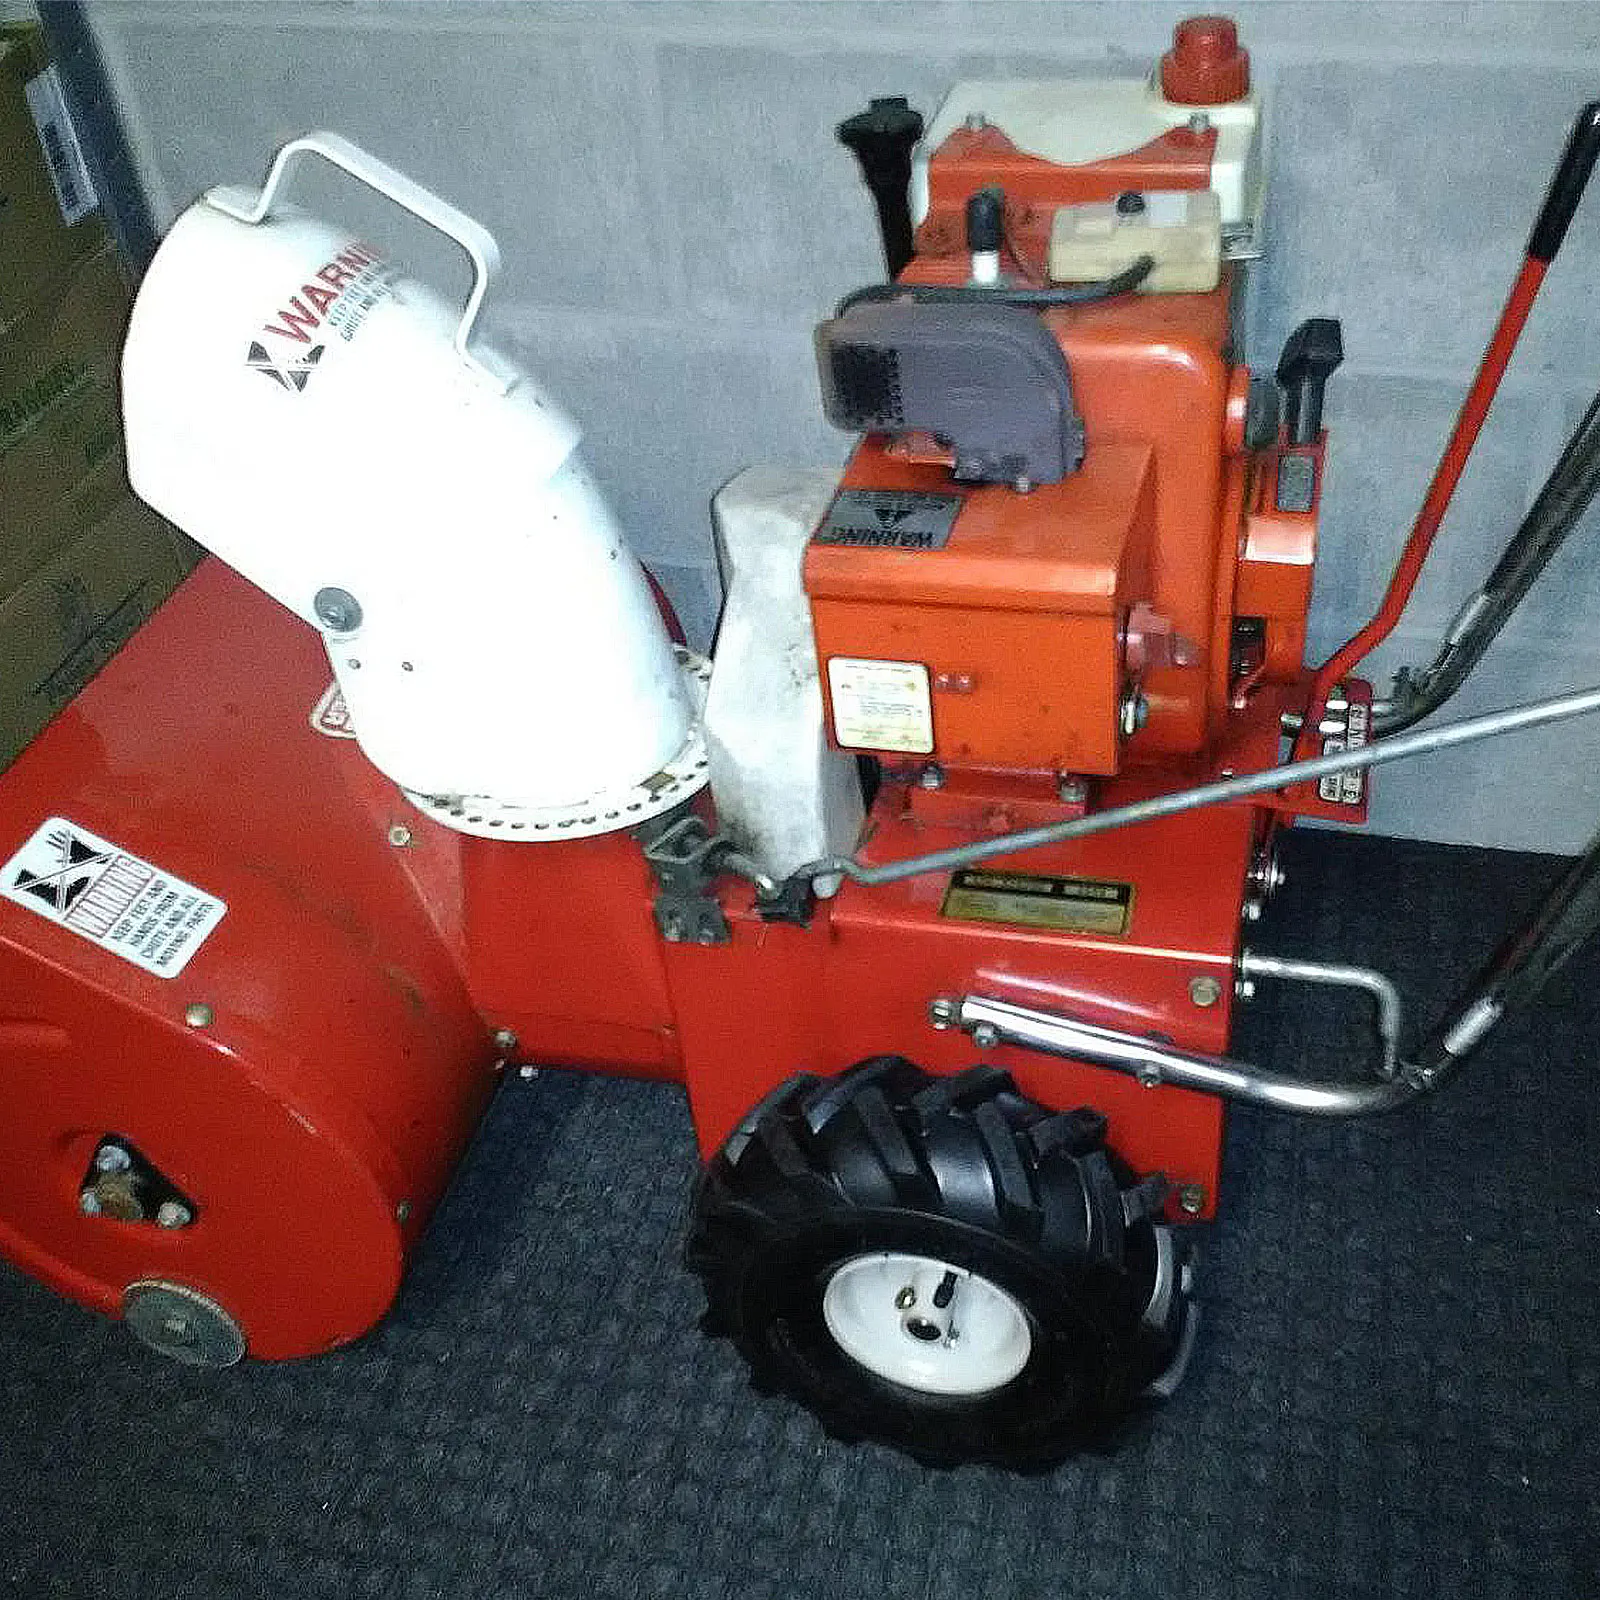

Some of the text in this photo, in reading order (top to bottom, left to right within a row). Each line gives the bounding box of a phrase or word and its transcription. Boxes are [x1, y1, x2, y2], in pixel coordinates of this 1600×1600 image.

[263, 240, 384, 343] WARNI
[63, 852, 156, 939] WARNING
[110, 879, 168, 942] KEEP FEET AND
[129, 891, 179, 947] HANDS FROM
[139, 895, 200, 959] CHUTE AND ALL
[156, 901, 214, 967] MOVING PARTS
